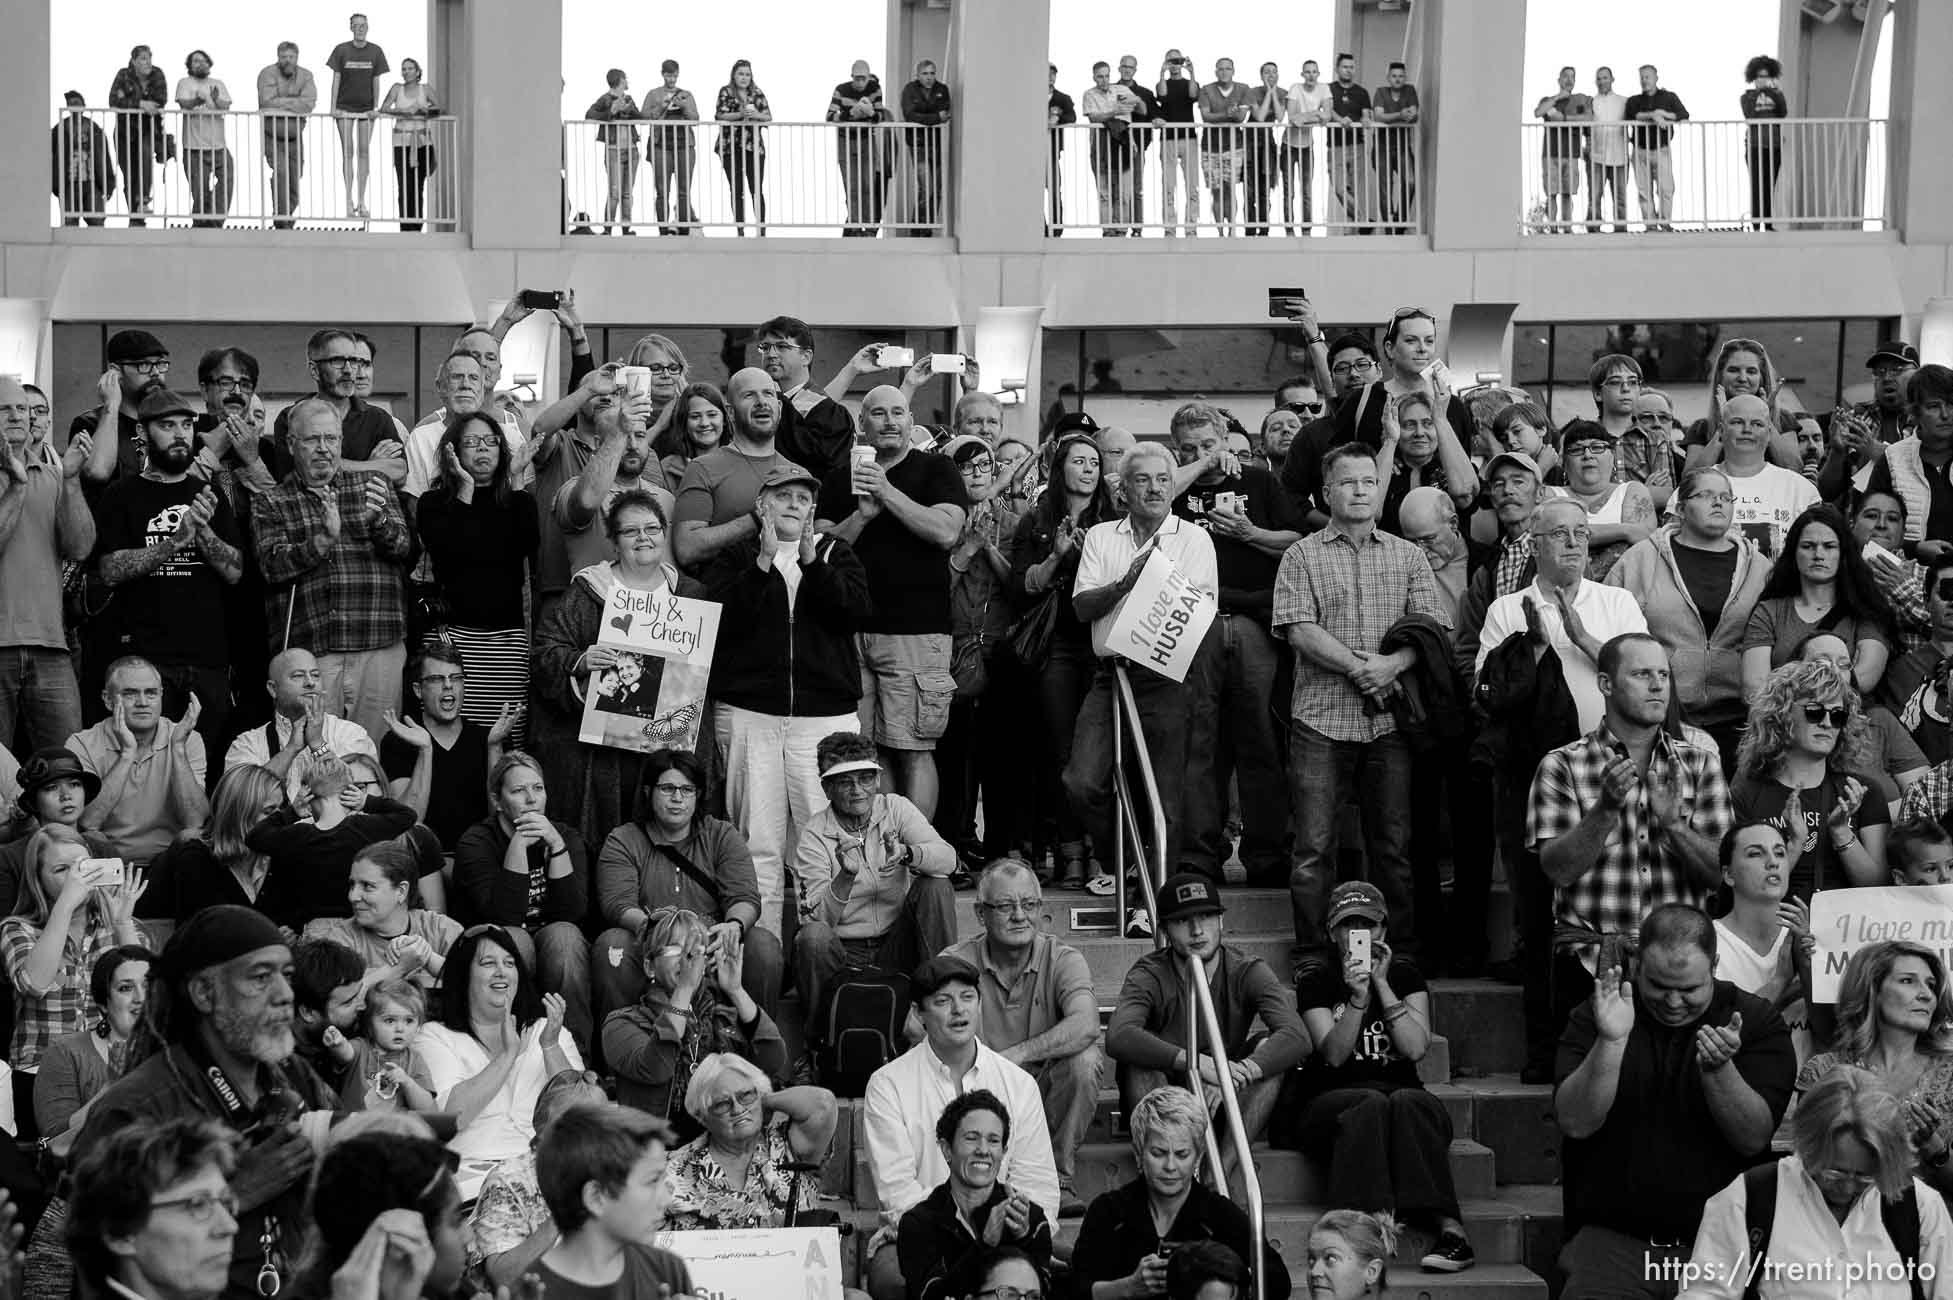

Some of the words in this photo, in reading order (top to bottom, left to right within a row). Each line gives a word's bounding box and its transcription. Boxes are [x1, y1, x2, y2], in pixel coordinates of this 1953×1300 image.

[613, 589, 661, 627] Shelly
[667, 597, 683, 622] &
[1138, 591, 1174, 635] love
[1165, 568, 1187, 592] m
[1150, 578, 1203, 667] HUSBAN
[651, 615, 703, 656] Cheryl
[1836, 914, 1851, 943] I
[1858, 915, 1913, 943] love
[208, 1066, 241, 1111] Canon
